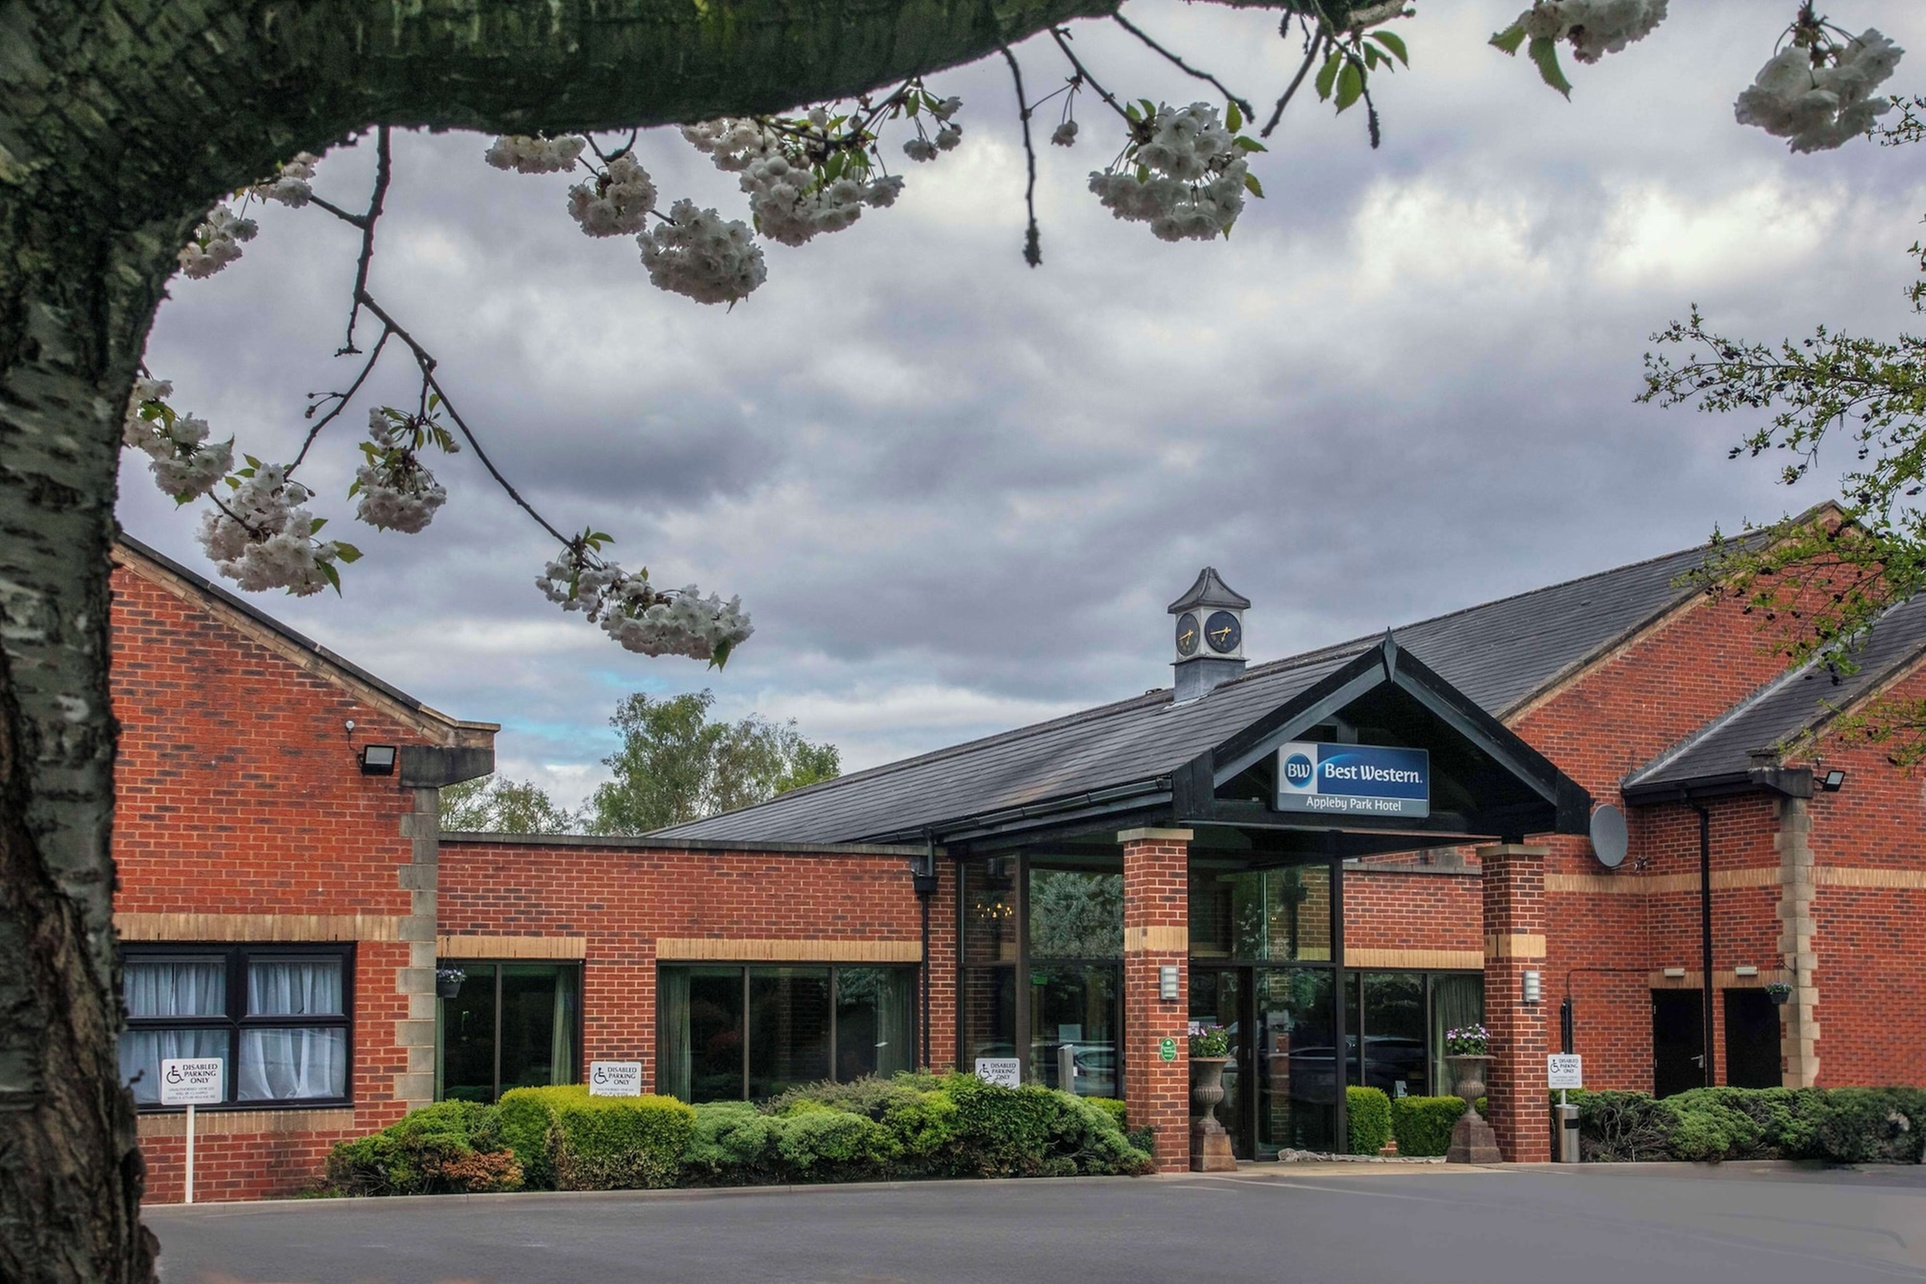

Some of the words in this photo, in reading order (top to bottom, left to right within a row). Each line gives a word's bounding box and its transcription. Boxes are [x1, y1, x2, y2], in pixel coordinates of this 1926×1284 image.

[1287, 763, 1310, 778] BW
[1325, 763, 1358, 780] Best
[1306, 796, 1347, 811] Appleby
[1350, 798, 1373, 810] Park
[1374, 800, 1402, 811] Hotel
